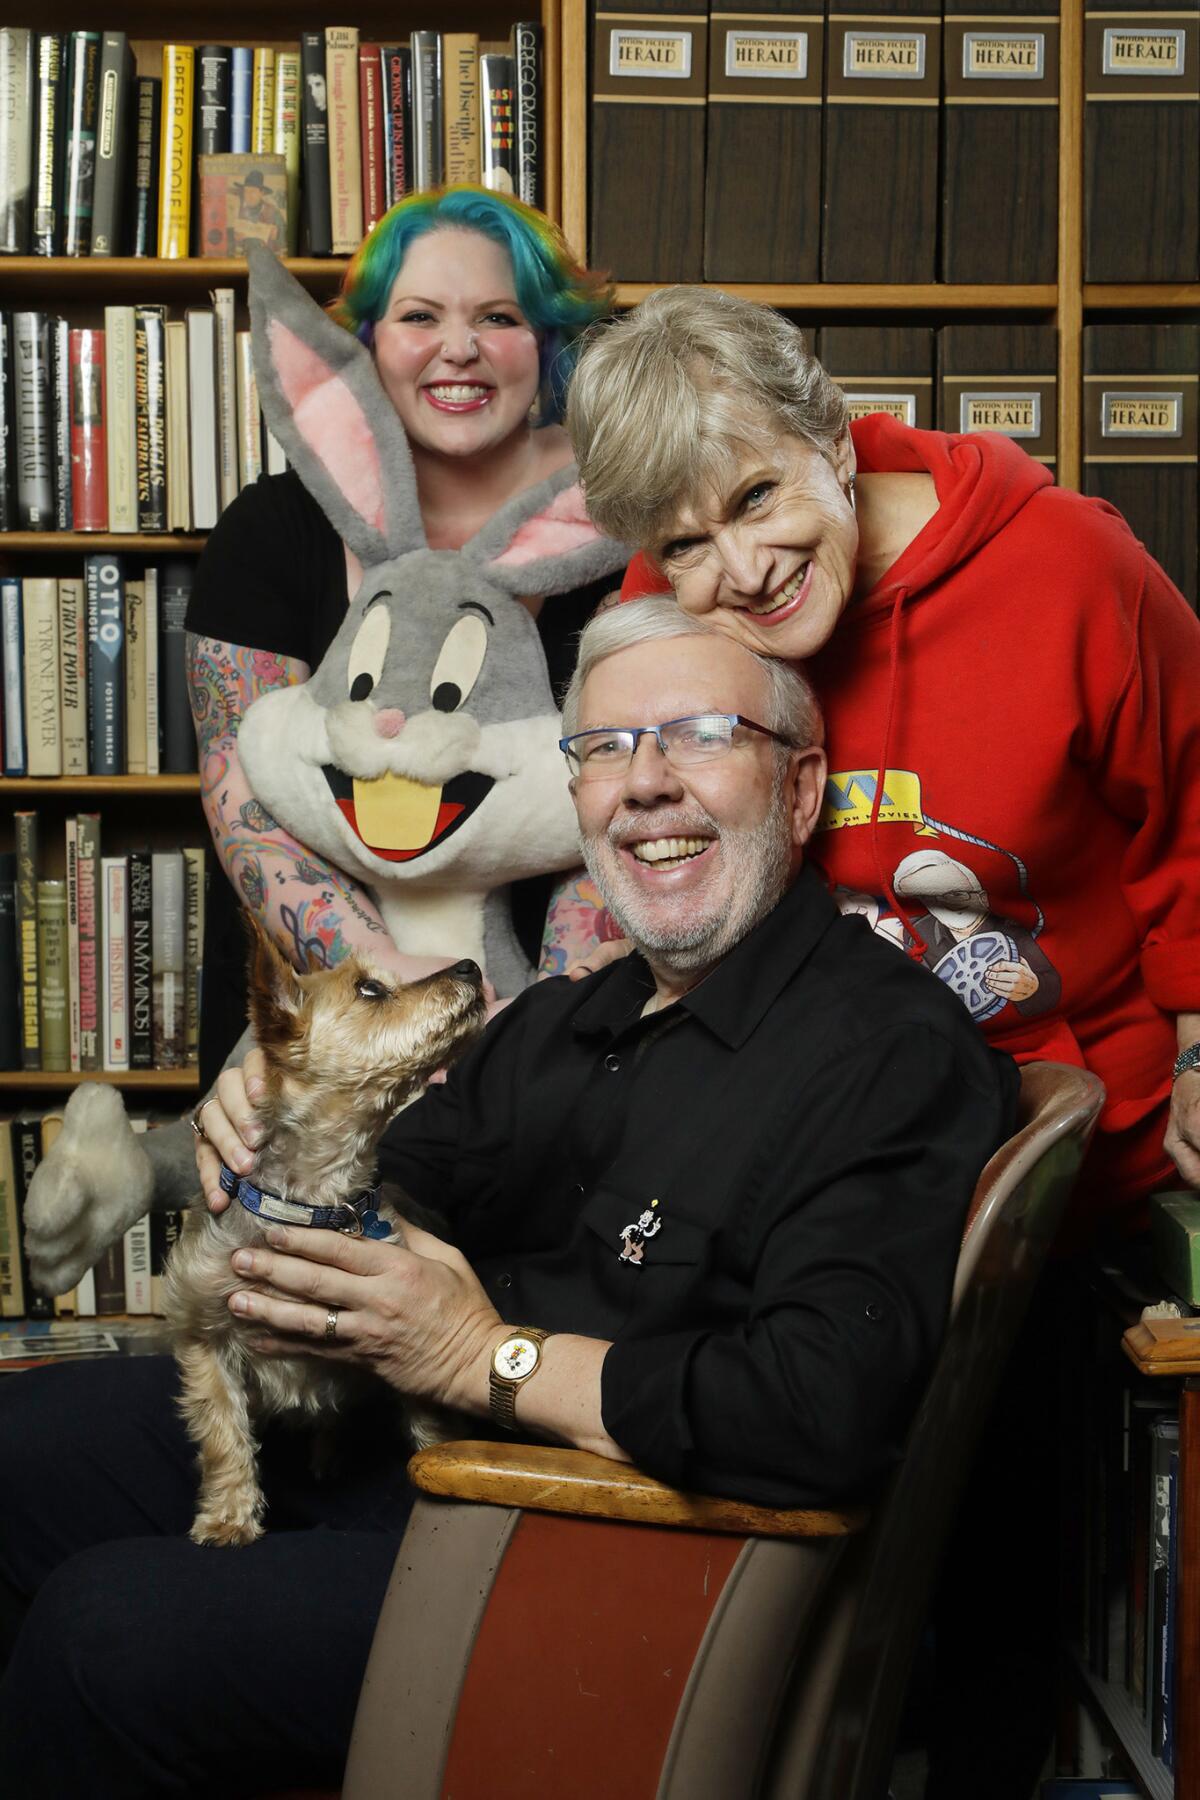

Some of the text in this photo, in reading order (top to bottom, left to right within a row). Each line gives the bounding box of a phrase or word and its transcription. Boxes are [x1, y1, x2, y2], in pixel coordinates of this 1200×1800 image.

[645, 39, 676, 47] PICTURE
[736, 47, 798, 63] HERALD
[767, 40, 797, 48] PICTURE
[856, 49, 917, 64] HERALD
[887, 41, 917, 49] PICTURE
[976, 49, 1036, 65] HERALD
[1007, 41, 1036, 49] PICTURE
[1115, 43, 1176, 59] HERALD
[173, 66, 185, 116] PETER
[455, 47, 476, 146] The Disciple
[489, 89, 513, 100] EASY
[520, 30, 537, 120] GREGORY
[391, 56, 406, 200] GROWING UP IN HOLLYWO
[492, 105, 512, 116] THE
[450, 125, 465, 183] and his
[491, 138, 513, 149] WAY
[519, 121, 537, 165] PECK
[170, 124, 184, 208] O'TOOLE
[19, 365, 49, 483] SPLIT IMAGE
[136, 330, 150, 502] PICKFORD FAIRBANKS
[972, 410, 1033, 425] HERALD
[1110, 410, 1169, 426] HERALD
[88, 565, 98, 642] PREMINGER
[100, 564, 120, 643] OTTO
[62, 586, 78, 710] TYRONE POWER
[38, 614, 56, 748] TYRONE POWER
[105, 682, 113, 765] FOSTER HIRSCH
[843, 815, 860, 823] ON
[187, 858, 198, 866] A
[187, 871, 198, 918] FAMILY
[78, 858, 97, 1030] ROBERT REDFORD
[134, 920, 149, 937] IN
[161, 911, 177, 967] Redgrave
[187, 921, 198, 931] &
[188, 937, 198, 957] ITS
[111, 936, 124, 1014] THIS IS LIVING
[134, 942, 149, 971] MY
[22, 919, 39, 1048] RONALD REAGAN
[130, 1231, 146, 1274] ROBSON
